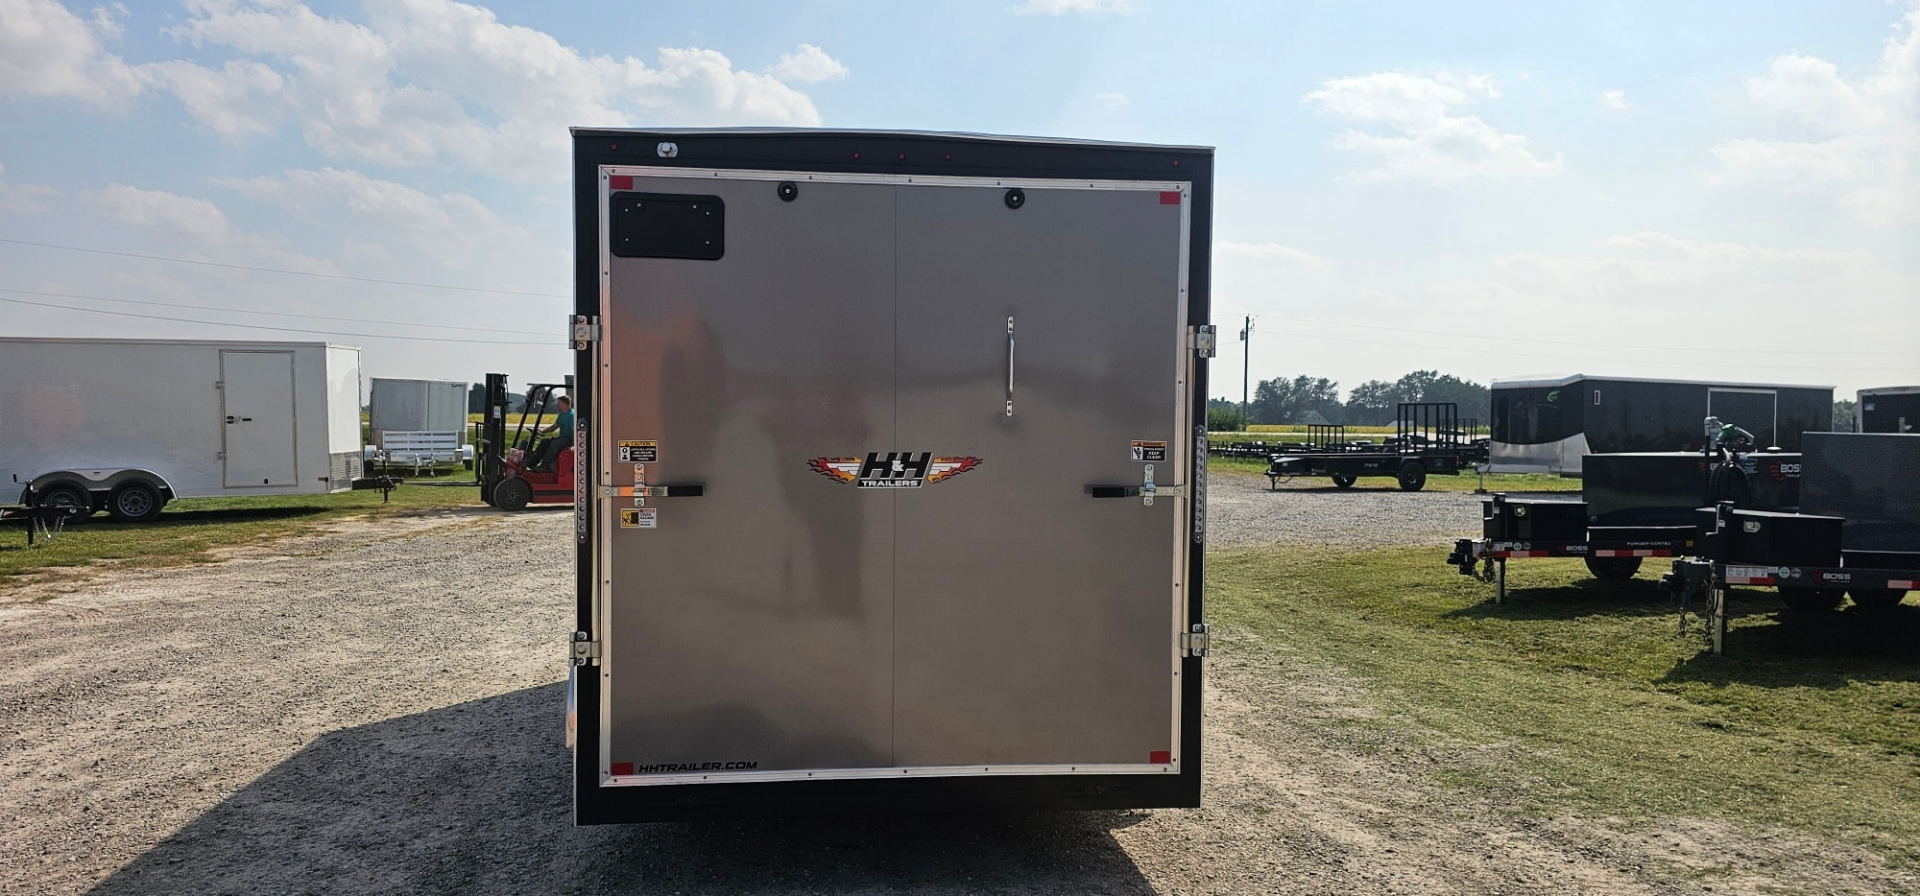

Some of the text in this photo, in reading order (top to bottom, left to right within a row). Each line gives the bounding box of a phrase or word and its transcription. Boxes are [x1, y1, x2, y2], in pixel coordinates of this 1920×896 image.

[860, 452, 933, 480] H&H
[1780, 464, 1802, 473] BOS
[638, 761, 758, 773] HHTRAILER.COM
